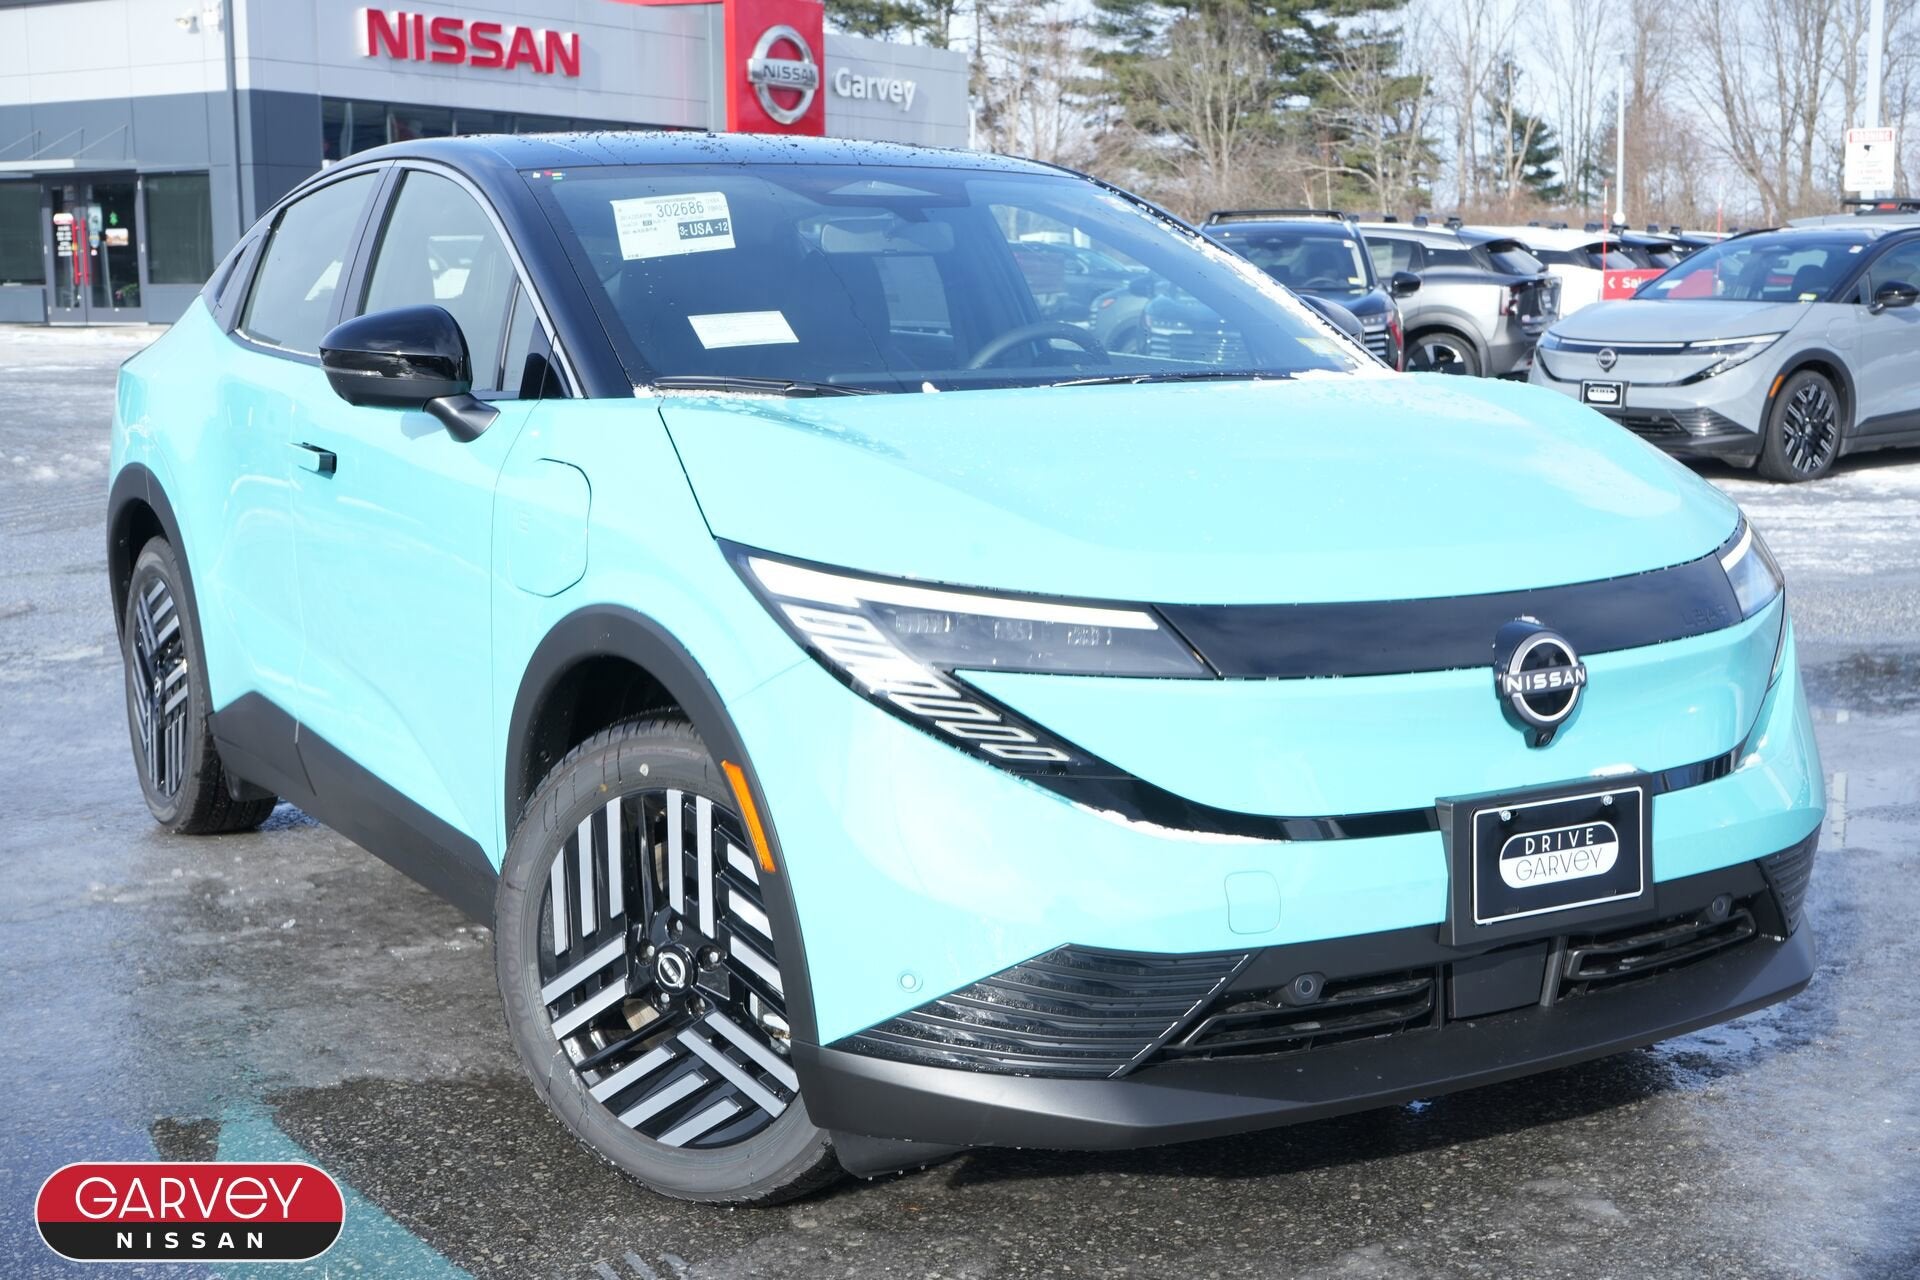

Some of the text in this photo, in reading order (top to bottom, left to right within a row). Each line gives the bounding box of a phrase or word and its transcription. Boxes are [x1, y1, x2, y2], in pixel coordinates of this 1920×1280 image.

[361, 7, 580, 77] NISSAN
[763, 64, 817, 82] NISSAN
[835, 66, 917, 111] Garvey
[656, 201, 705, 218] 302686
[1621, 276, 1644, 289] Sal
[1506, 667, 1586, 693] NISSAN
[1525, 827, 1594, 855] DRIVE
